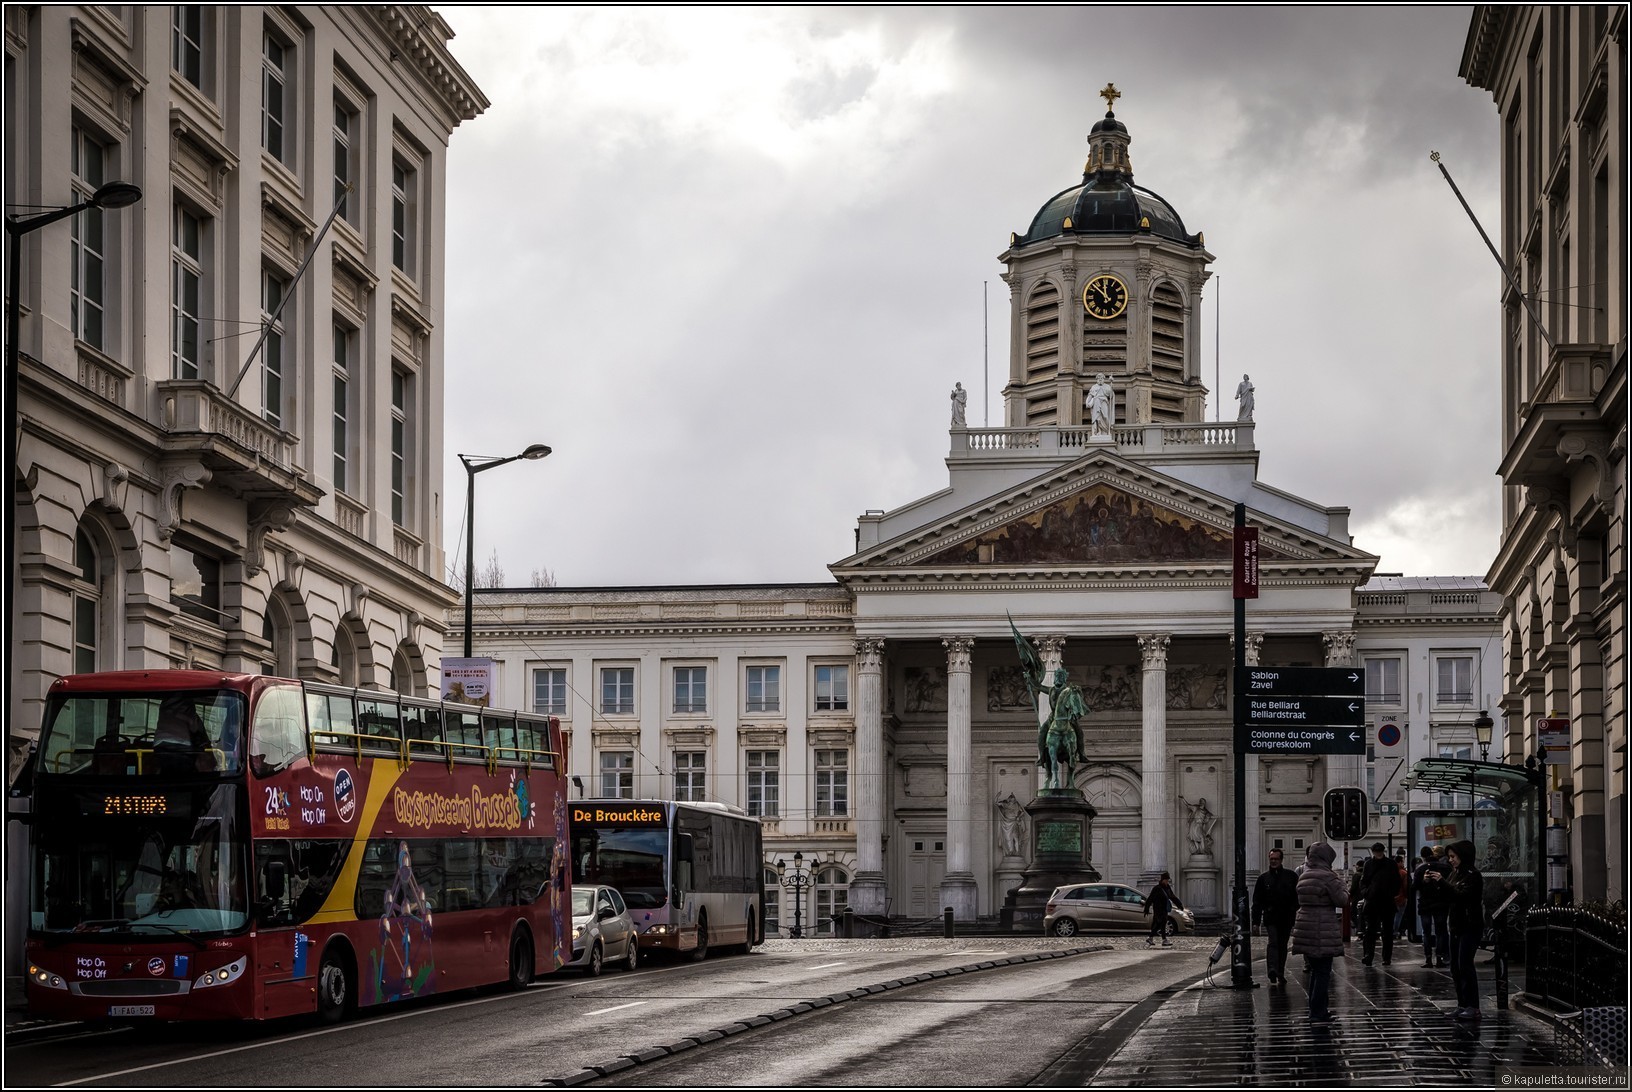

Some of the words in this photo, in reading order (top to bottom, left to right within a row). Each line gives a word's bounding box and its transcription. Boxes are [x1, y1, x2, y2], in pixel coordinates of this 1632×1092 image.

[1251, 671, 1279, 680] Sablon
[1251, 681, 1273, 689] Zavel
[1251, 701, 1267, 709] Rue
[1268, 701, 1300, 709] Belliard
[1251, 711, 1306, 719] Belliardstraat
[1251, 730, 1286, 739] Colonne
[1287, 730, 1299, 739] du
[1300, 730, 1335, 741] Congrès
[1251, 740, 1311, 749] Congreskolom
[335, 776, 351, 795] OPEN
[300, 785, 314, 803] Hop
[314, 785, 324, 803] On
[124, 796, 166, 814] STOPS
[265, 786, 280, 815] 24
[339, 798, 354, 817] TOURS
[472, 784, 521, 831] Brussels
[301, 807, 315, 825] Hop
[315, 807, 326, 825] Off
[574, 809, 591, 822] De
[596, 808, 661, 822] Brouckère
[77, 957, 93, 967] Hop
[94, 957, 106, 967] On
[77, 968, 93, 979] Hop
[94, 968, 107, 978] Off
